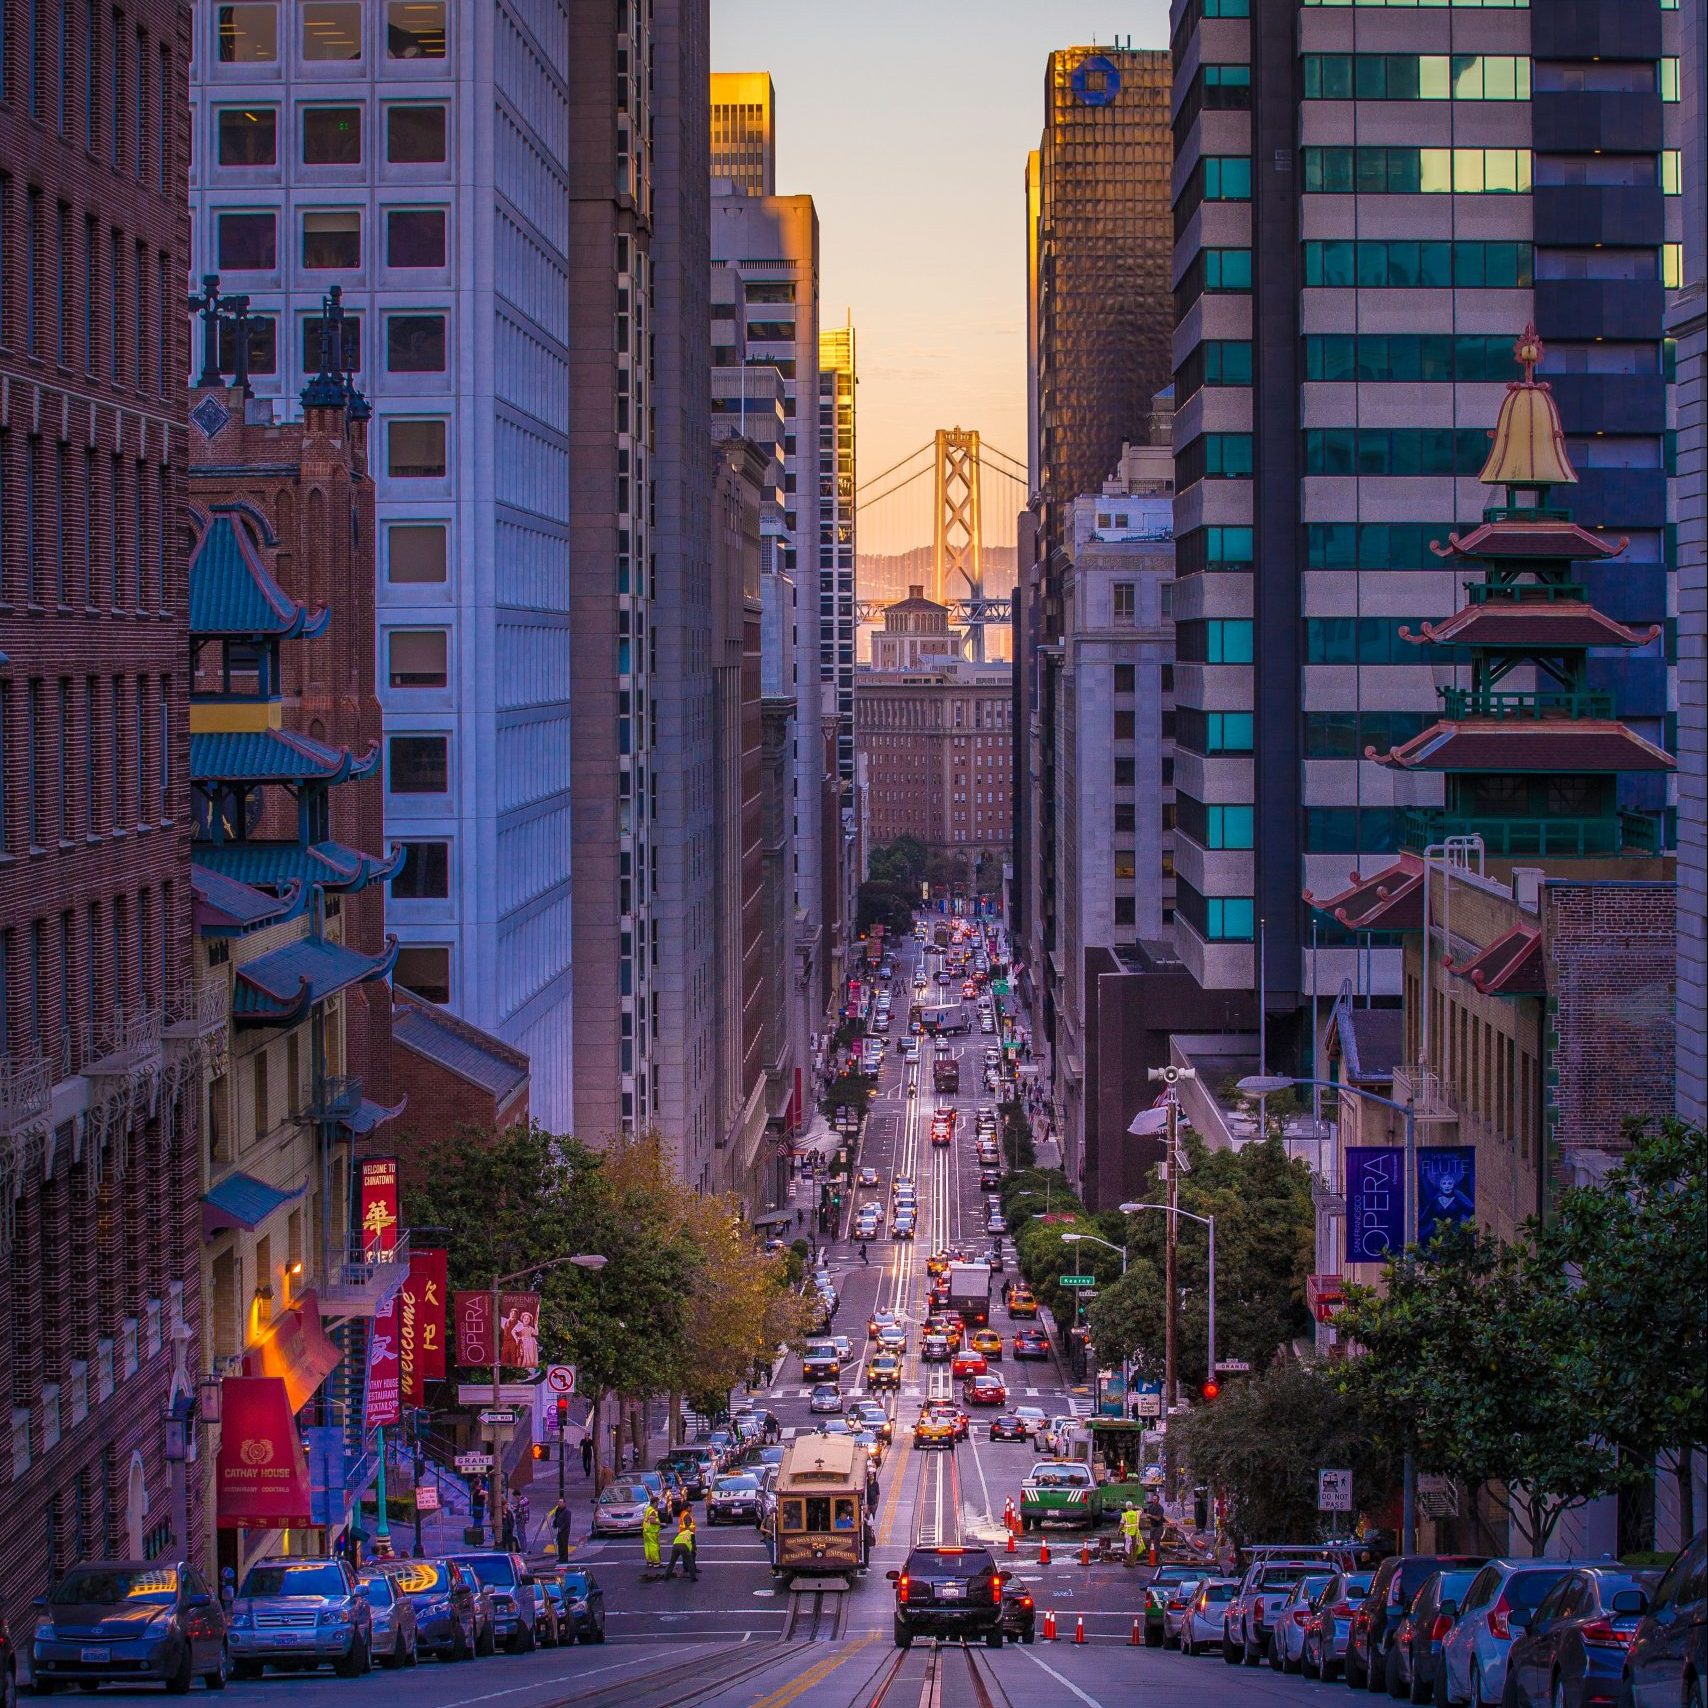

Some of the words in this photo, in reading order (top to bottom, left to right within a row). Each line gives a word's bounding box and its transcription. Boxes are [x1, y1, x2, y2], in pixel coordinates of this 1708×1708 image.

[363, 1164, 387, 1175] WELCOME
[389, 1163, 396, 1173] TO
[1421, 1160, 1470, 1175] FLUTE
[364, 1174, 394, 1186] CHINATOWN
[1363, 1154, 1390, 1256] OPERA
[465, 1296, 485, 1363] OPERA
[383, 1378, 399, 1388] HOUSE
[368, 1389, 398, 1401] ESTAURANT
[224, 1468, 258, 1478] CATHAY
[261, 1468, 290, 1478] HOUSE
[1334, 1493, 1348, 1501] NOT
[1325, 1501, 1344, 1509] PASS
